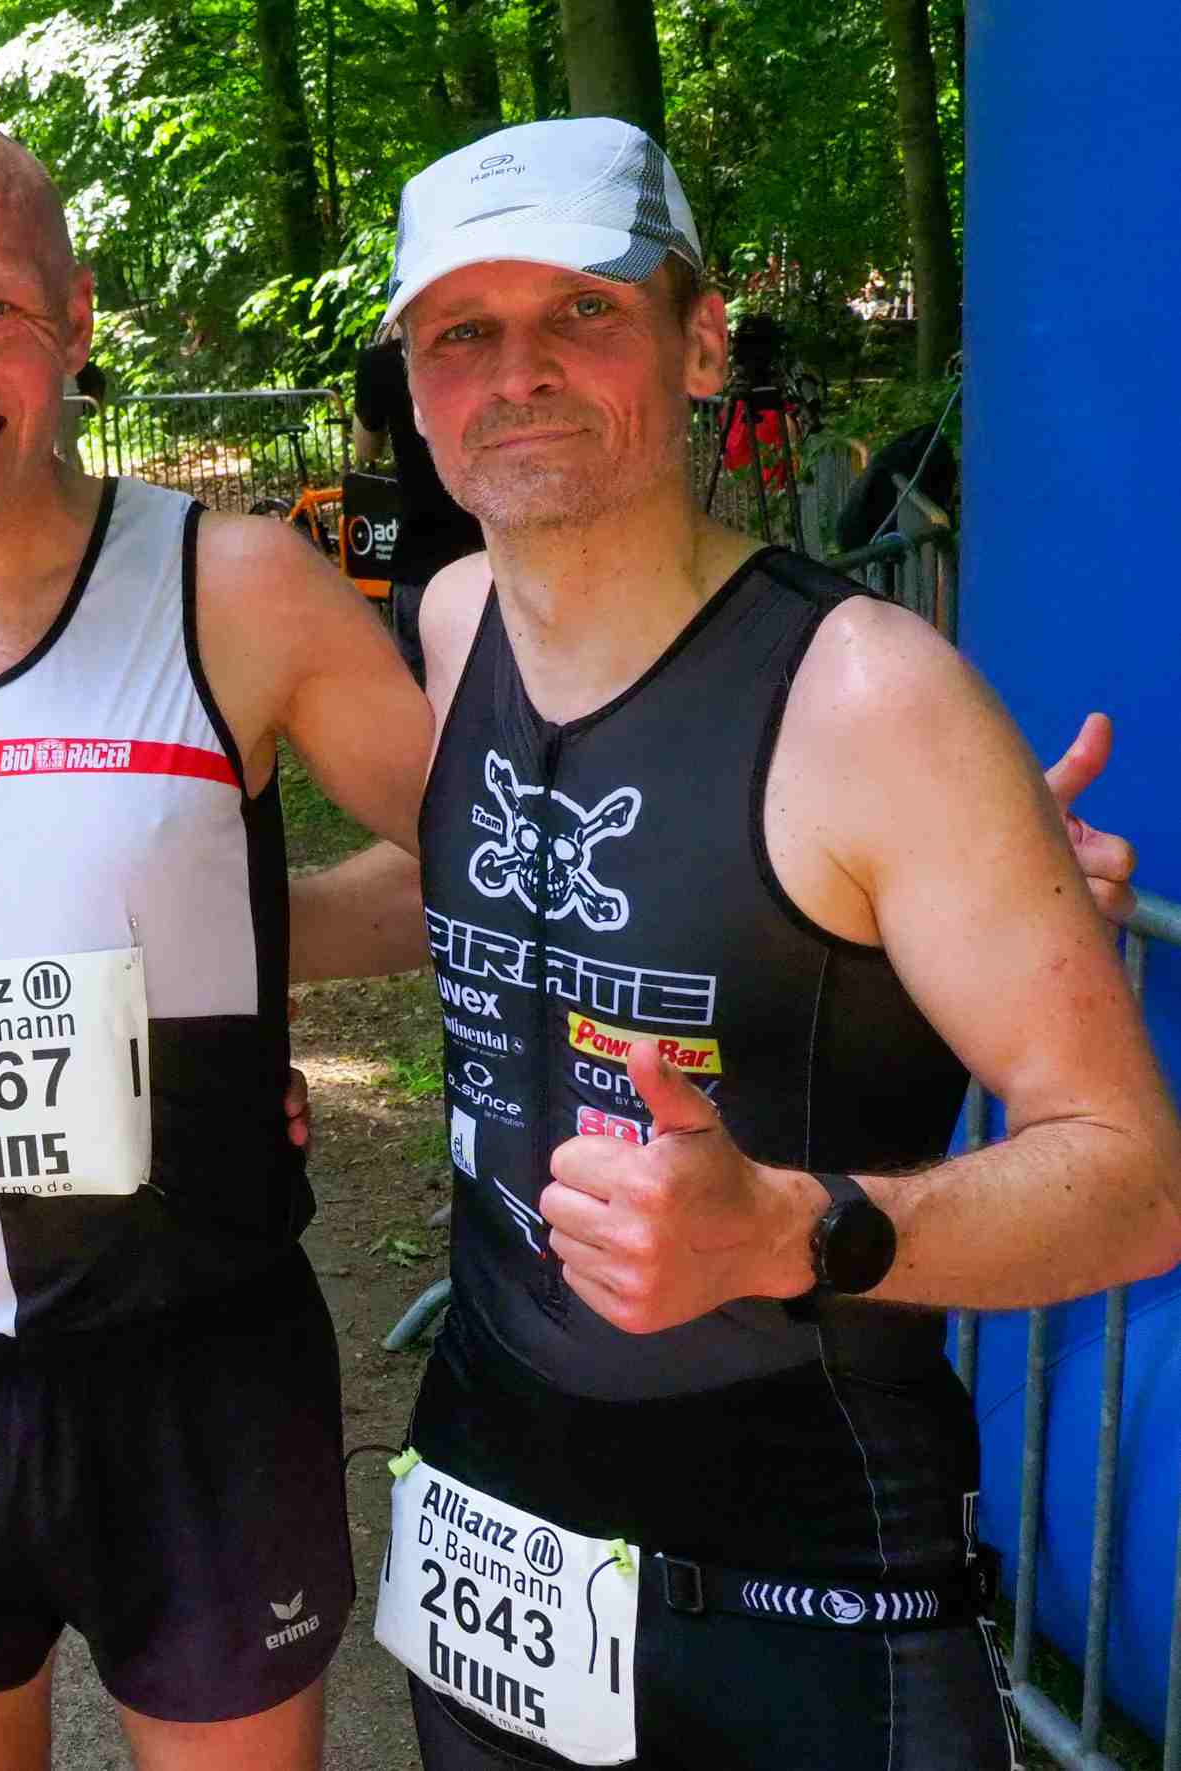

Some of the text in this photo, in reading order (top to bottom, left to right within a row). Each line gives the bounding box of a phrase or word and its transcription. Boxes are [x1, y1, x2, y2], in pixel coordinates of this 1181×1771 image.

[66, 741, 131, 769] RACER
[473, 807, 502, 833] Team
[435, 969, 501, 1020] uvex
[575, 1019, 714, 1069] PowBar
[422, 1480, 517, 1553] Allianz
[419, 1515, 562, 1609] D. Baumann
[265, 1614, 320, 1650] erima
[419, 1558, 556, 1668] 2643
[429, 1621, 546, 1729] bruns
